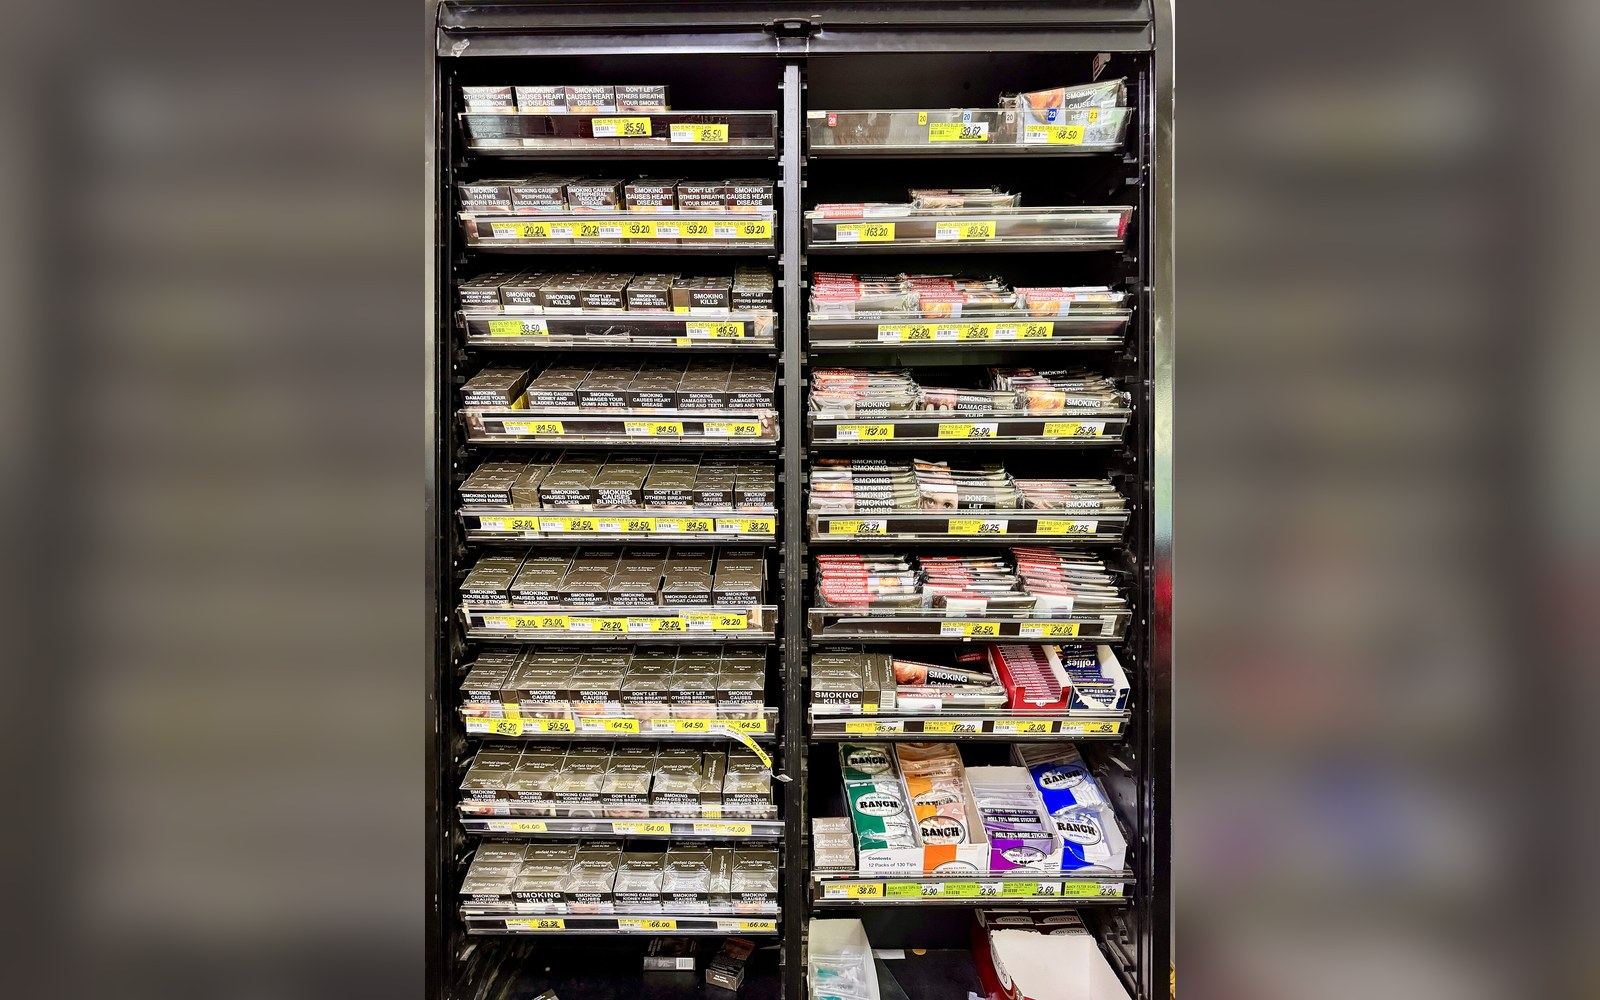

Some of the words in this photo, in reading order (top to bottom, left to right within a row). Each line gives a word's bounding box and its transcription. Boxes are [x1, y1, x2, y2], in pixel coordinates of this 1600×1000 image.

[1066, 89, 1097, 99] SMOKING
[928, 670, 968, 683] SMOKING
[922, 827, 959, 836] RANCH
[1057, 822, 1095, 835] RANCH
